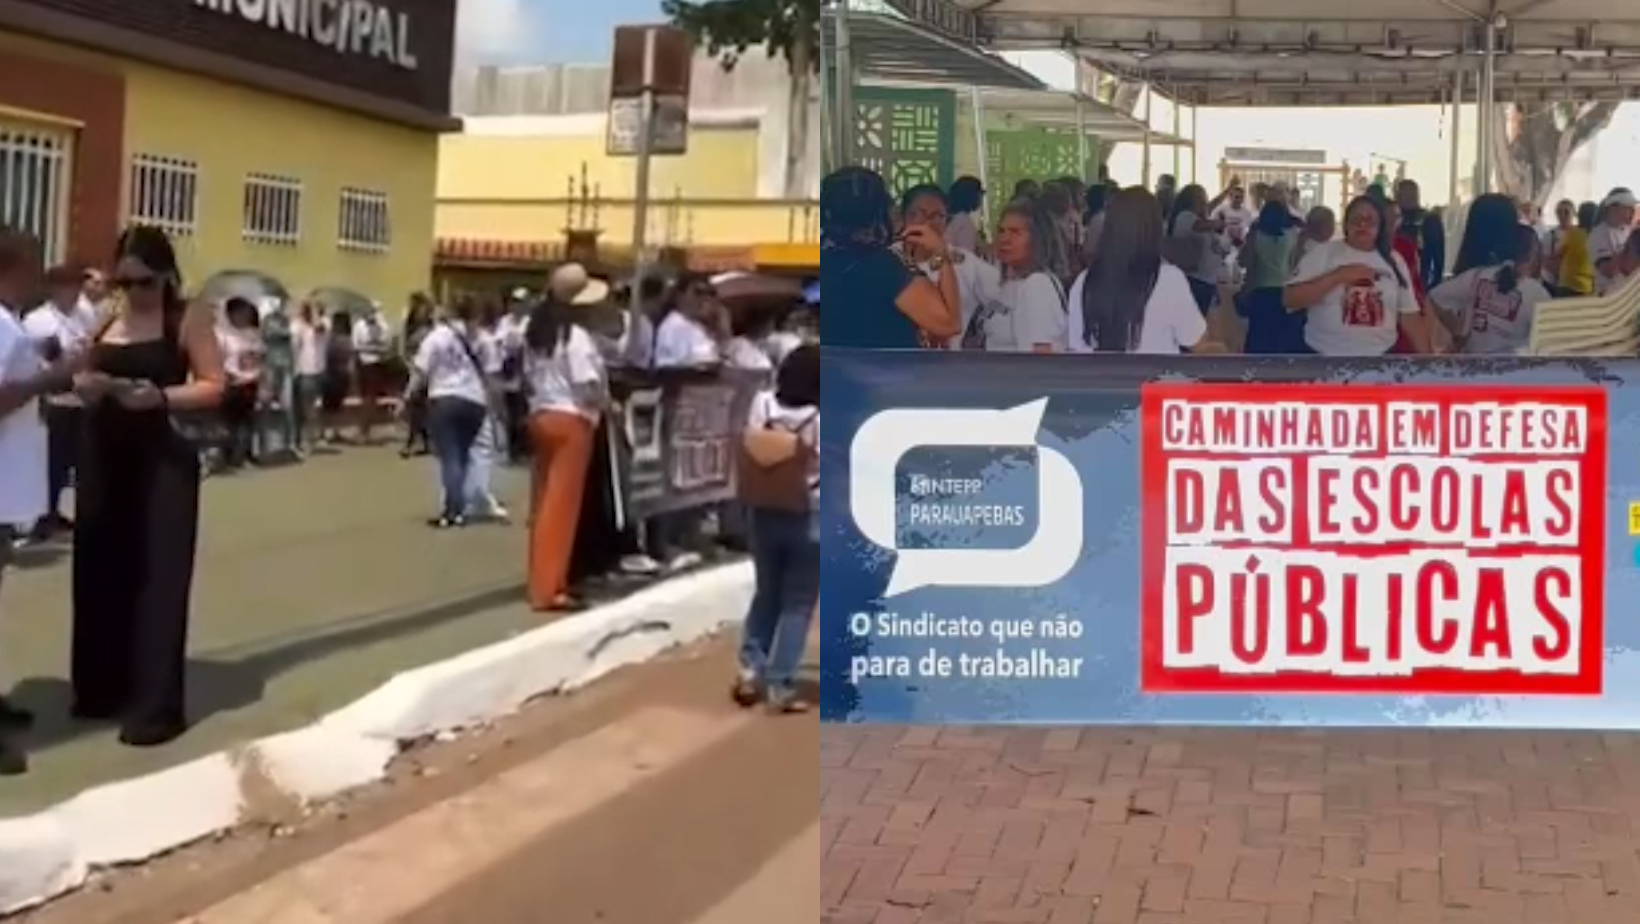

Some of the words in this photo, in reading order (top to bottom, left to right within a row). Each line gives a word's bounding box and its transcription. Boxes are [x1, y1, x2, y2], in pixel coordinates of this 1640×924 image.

[1164, 404, 1374, 449] CAMINHADA
[1393, 408, 1437, 447] EM
[1454, 408, 1581, 449] DEFESA
[910, 503, 1025, 526] PARAUAPEBAS
[1174, 466, 1286, 534] DAS
[1318, 463, 1574, 538] ESCOLAS
[851, 612, 872, 636] O
[877, 612, 984, 637] Sindicato
[990, 618, 1034, 643] que
[1040, 613, 1084, 638] não
[1175, 554, 1571, 664] PÚBLICAS
[851, 655, 911, 684] para
[918, 648, 952, 677] de
[959, 648, 1084, 678] trabalhar
